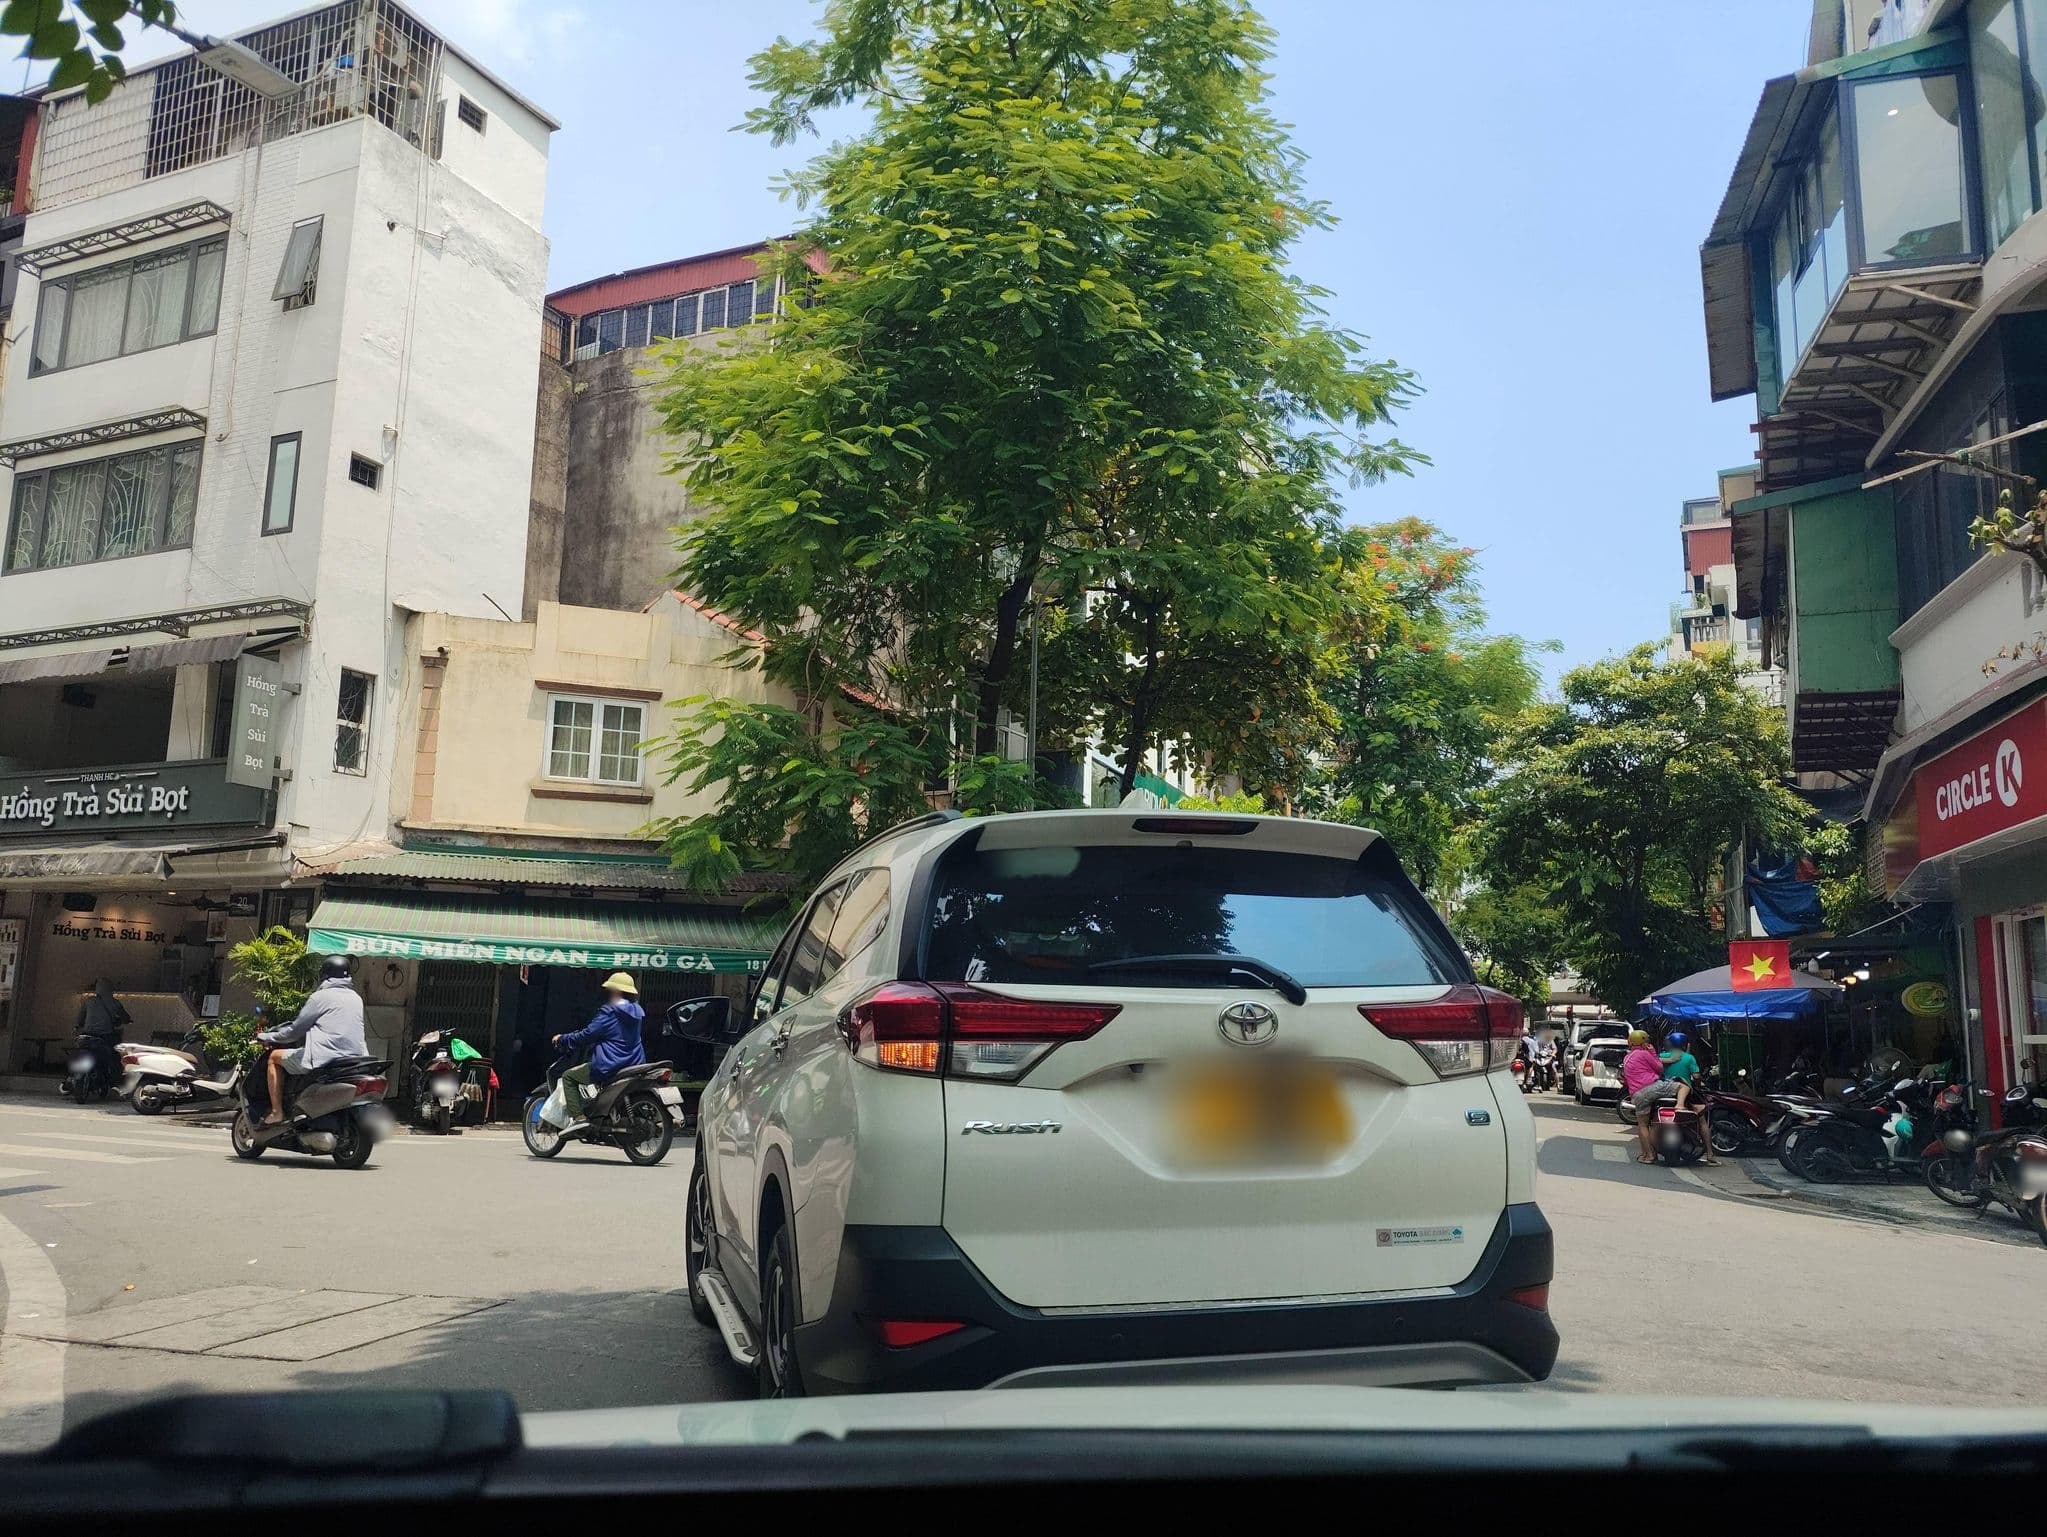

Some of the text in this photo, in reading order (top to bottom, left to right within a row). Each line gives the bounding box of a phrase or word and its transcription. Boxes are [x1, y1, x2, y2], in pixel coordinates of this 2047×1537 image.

[246, 673, 277, 697] Hồng
[249, 703, 269, 717] Trà
[247, 728, 266, 742] Sủi
[245, 755, 264, 770] Bọt
[81, 773, 104, 782] THANH
[1936, 746, 2022, 821] CIRCLE K
[0, 783, 189, 827] Hồng Trà Sủi Bọt
[52, 921, 91, 941] Hồng
[94, 926, 116, 939] Trà
[144, 931, 166, 945] Bọt
[347, 936, 411, 955] BÚN
[505, 945, 589, 965] NGAN
[614, 949, 669, 968] PHỞ
[676, 953, 715, 971] GÀ
[746, 960, 759, 970] 18
[961, 1119, 1063, 1135] Rush
